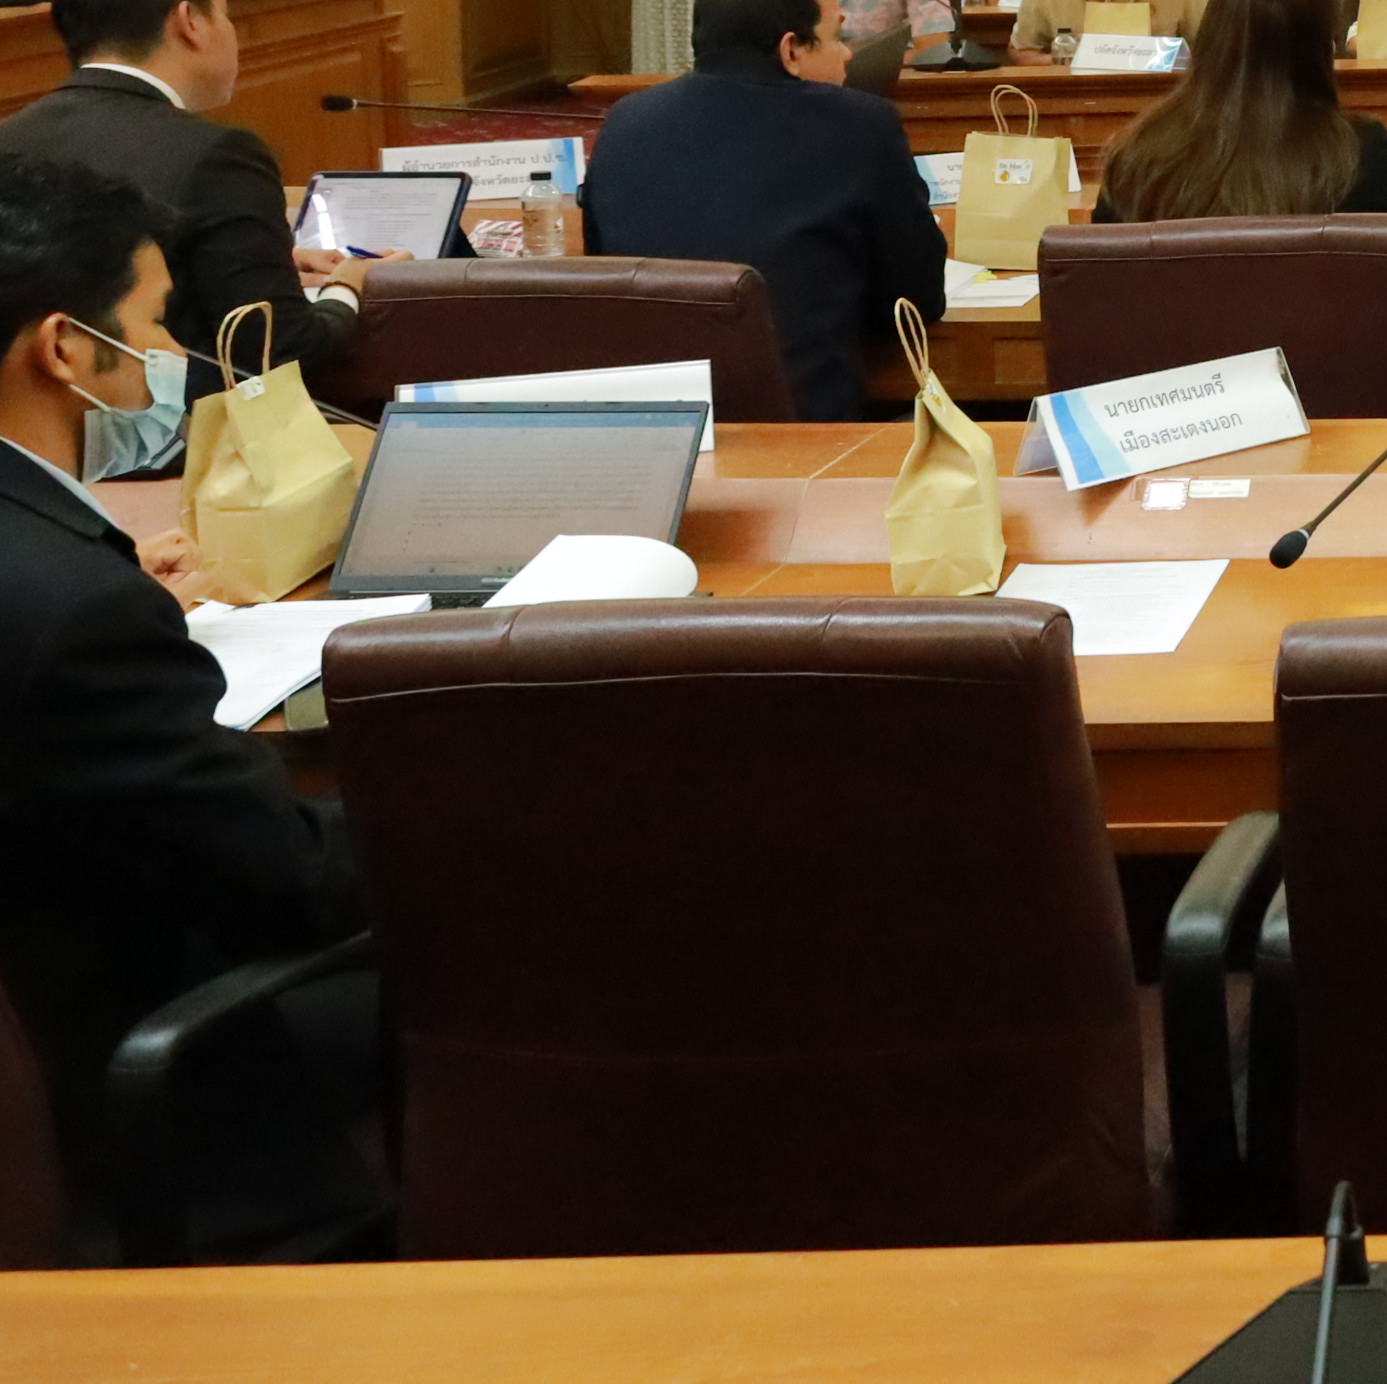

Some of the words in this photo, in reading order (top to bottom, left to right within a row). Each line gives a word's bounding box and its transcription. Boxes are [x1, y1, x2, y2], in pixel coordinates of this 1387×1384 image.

[1104, 373, 1226, 418] นายกเทศมนตรี
[1119, 411, 1242, 454] เมืองสะเตงนอก
